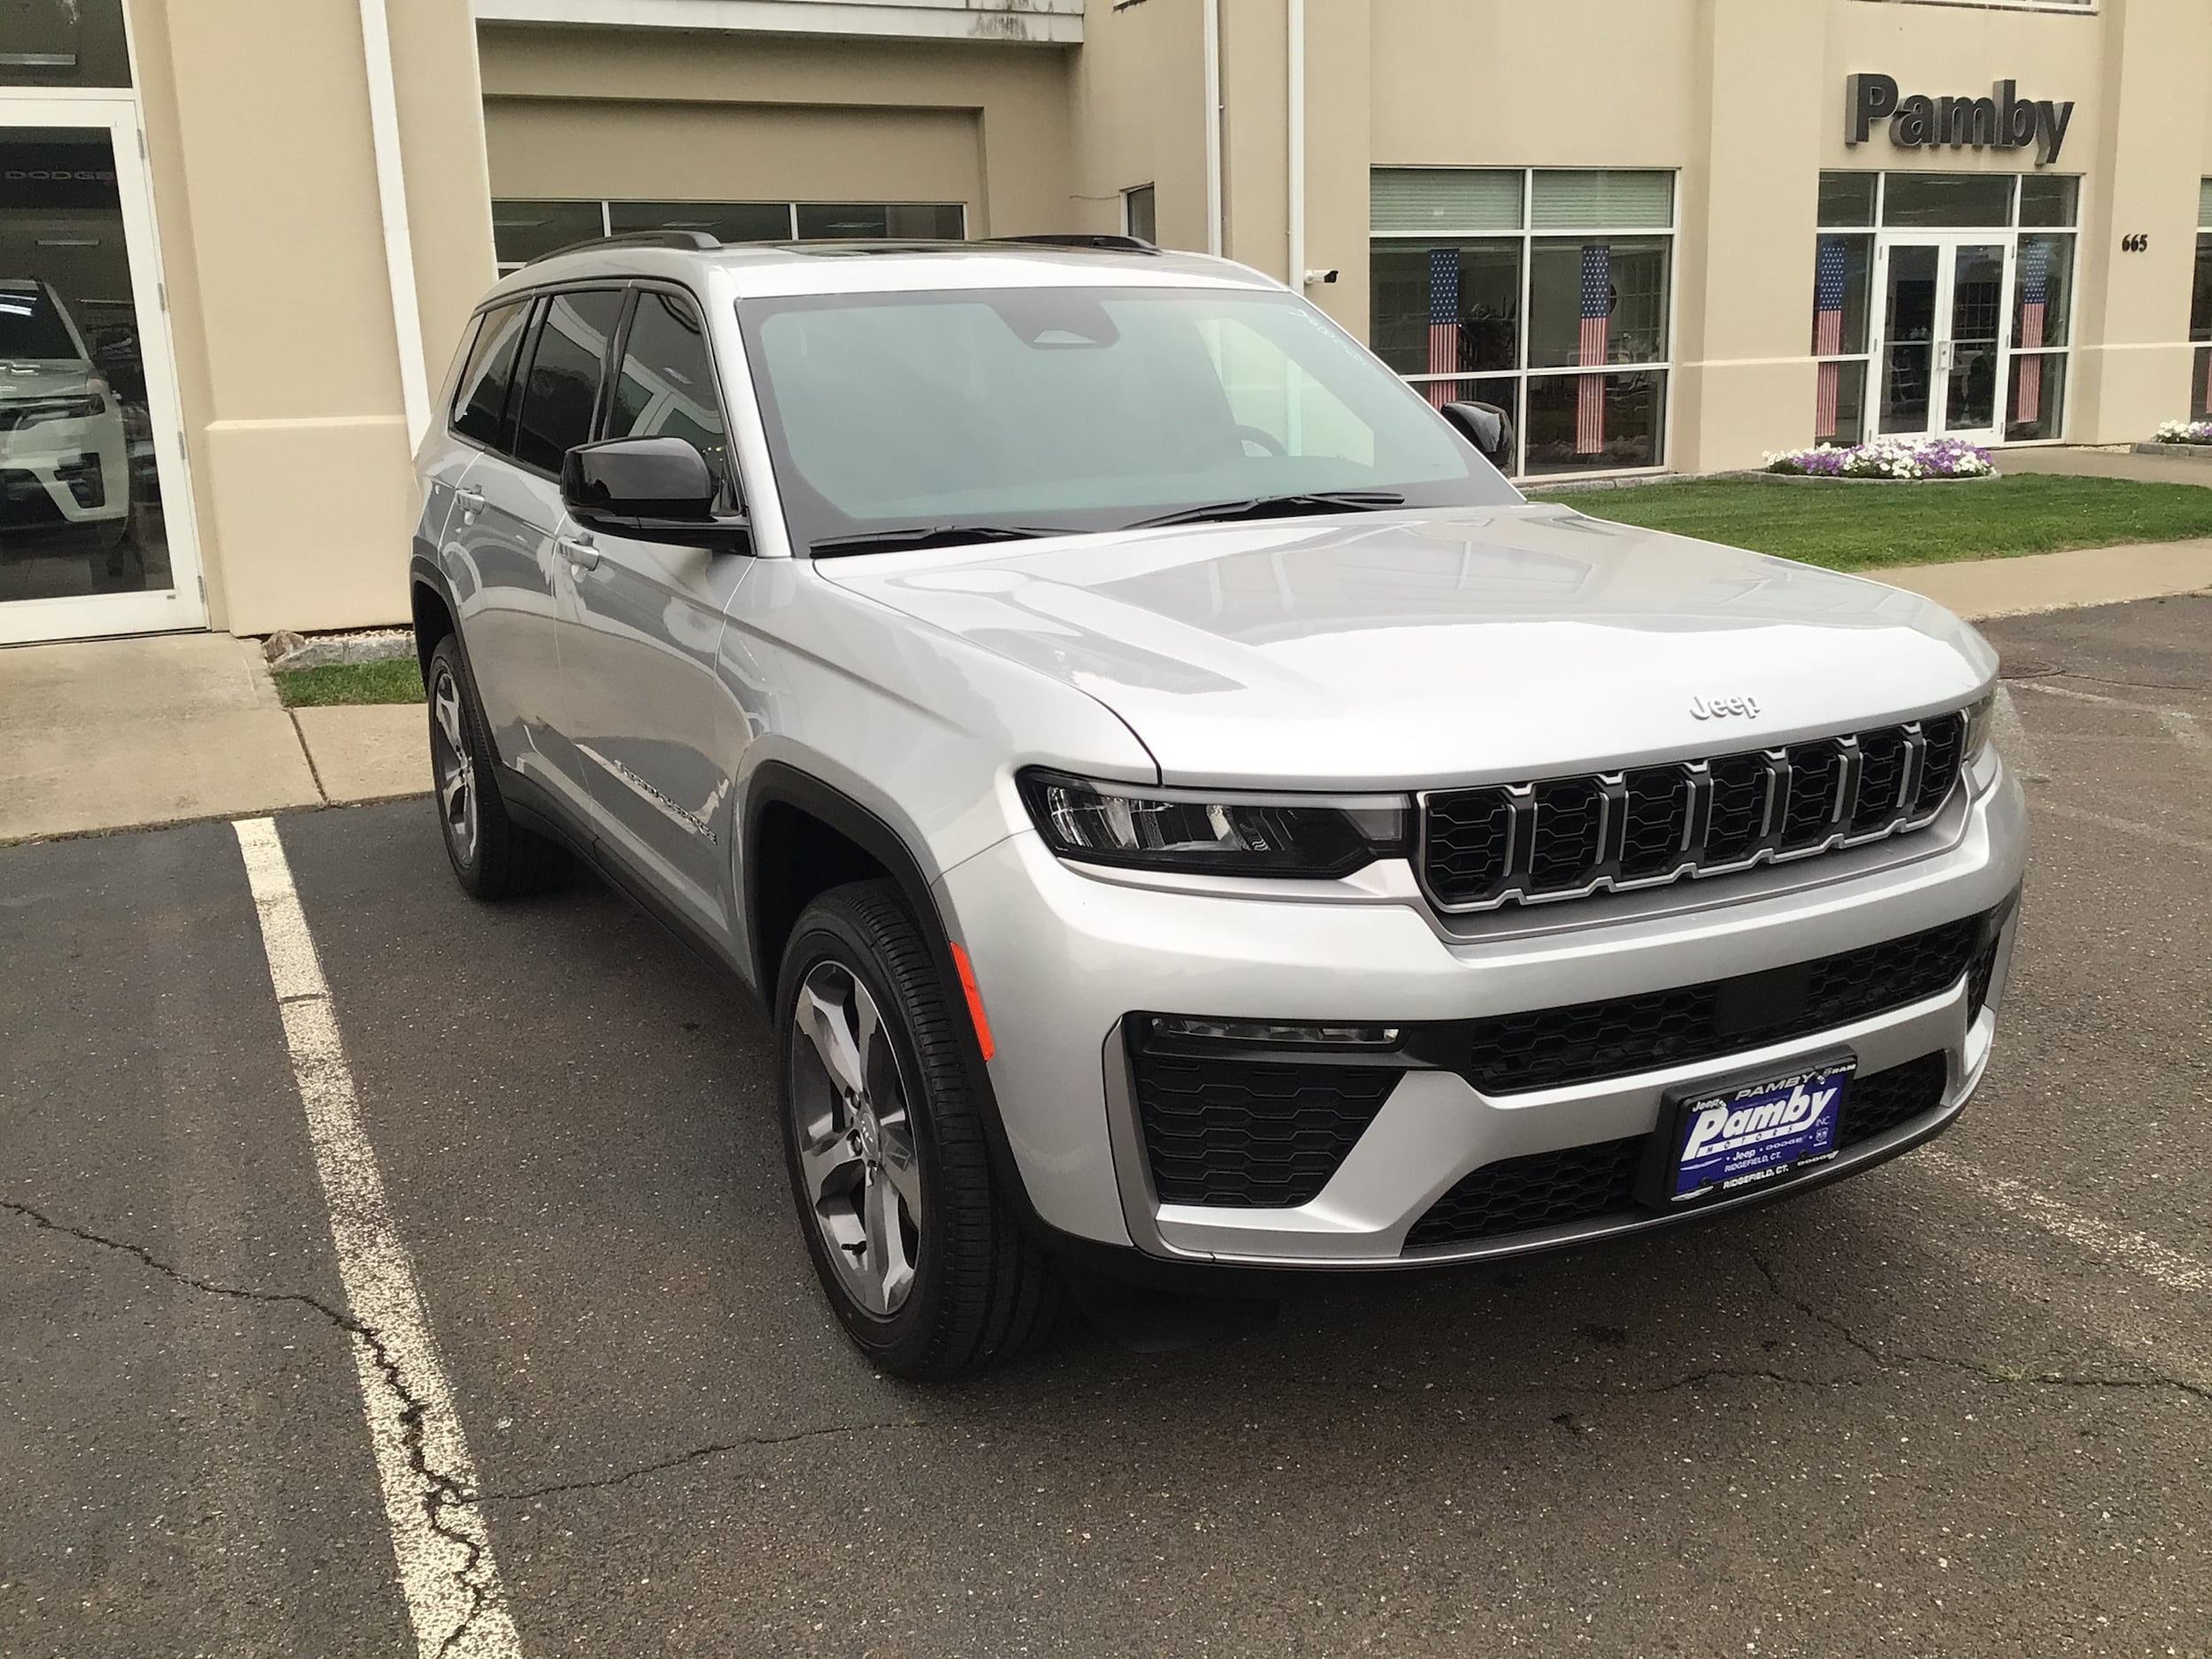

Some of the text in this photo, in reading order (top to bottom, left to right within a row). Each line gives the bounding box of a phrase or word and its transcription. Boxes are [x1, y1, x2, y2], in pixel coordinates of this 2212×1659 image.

[1846, 73, 2075, 165] Pamby
[4, 170, 116, 180] DODGE
[2121, 234, 2148, 252] 665
[1689, 695, 1761, 720] Jeep
[1832, 1064, 1856, 1074] RAM
[1735, 1071, 1816, 1101] PAMBY
[1681, 1085, 1839, 1162] Pamby
[1707, 1125, 1793, 1154] MOTORS
[1765, 1137, 1803, 1150] DODGE
[1724, 1151, 1782, 1172] RIDGEFIELD, CT.
[1732, 1148, 1756, 1161] Jeep
[1723, 1164, 1789, 1189] RIDGEFIELD, CT.
